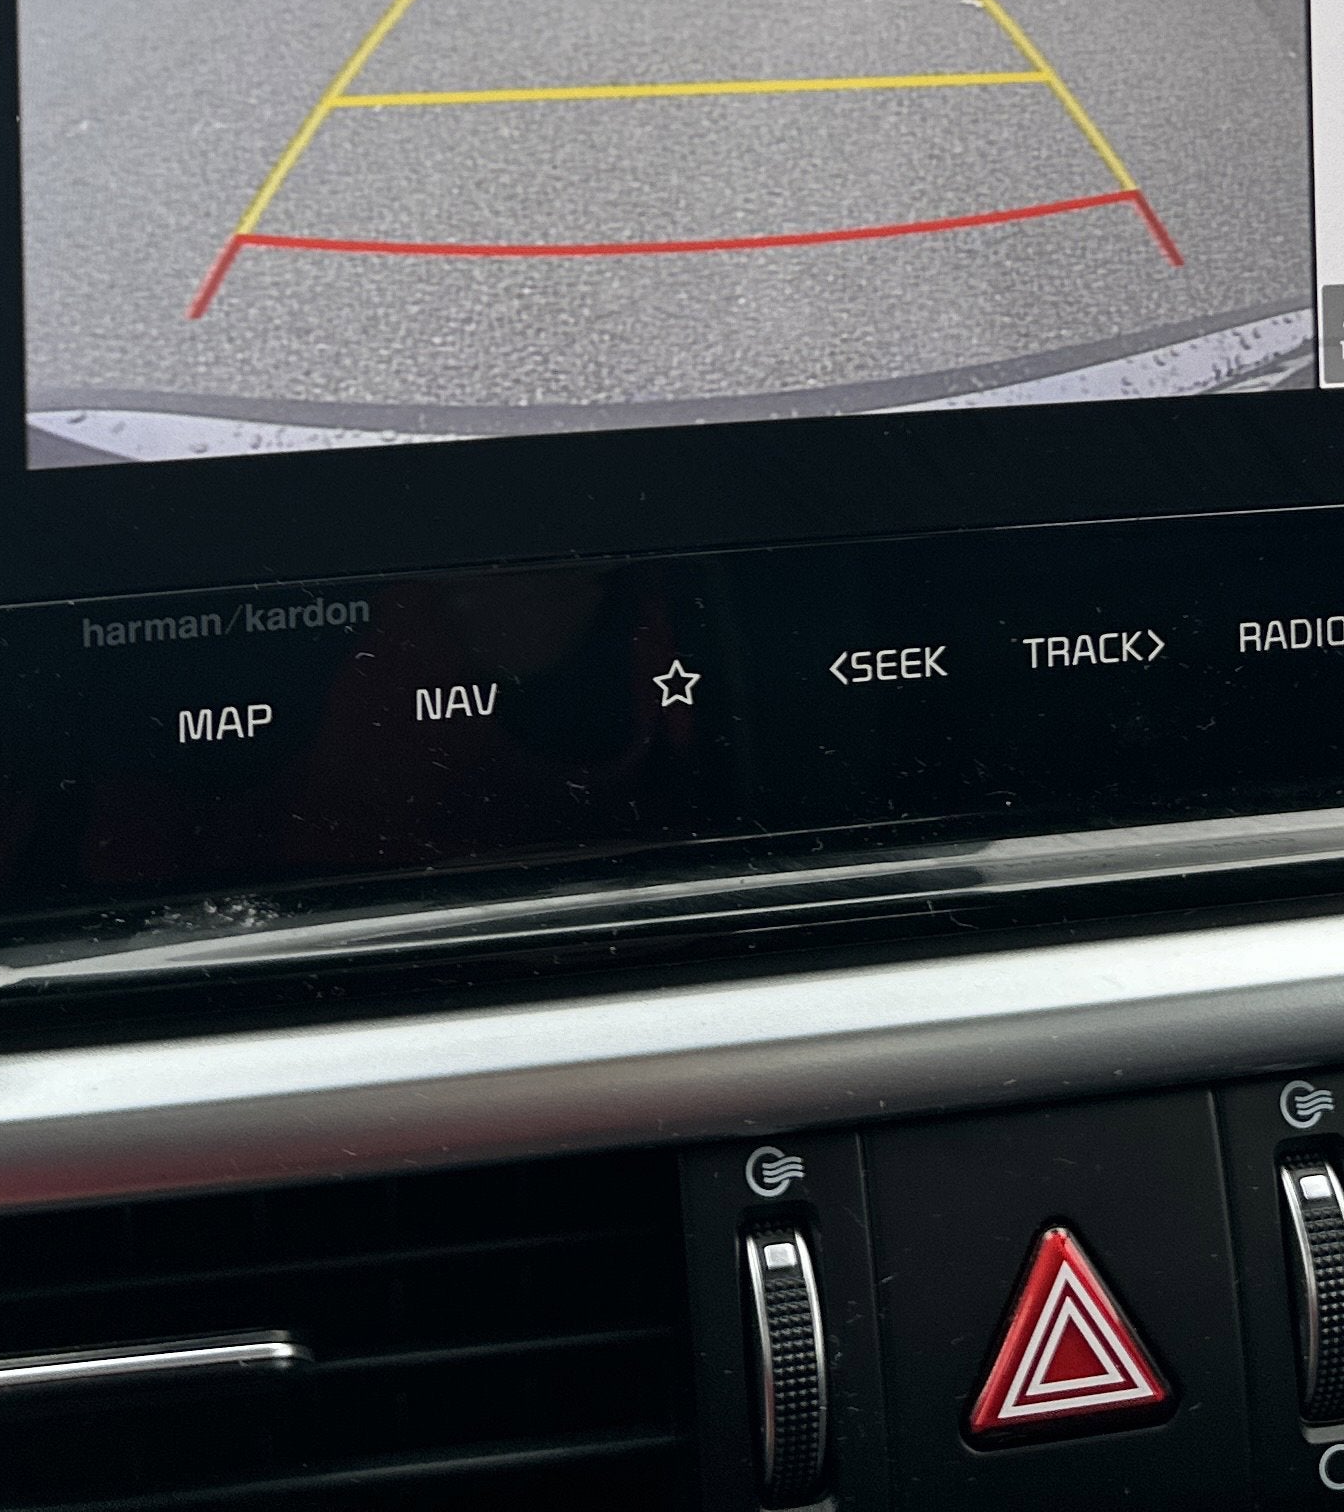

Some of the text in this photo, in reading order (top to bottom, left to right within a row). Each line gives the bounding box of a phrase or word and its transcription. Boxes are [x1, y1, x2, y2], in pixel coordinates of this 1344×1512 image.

[82, 597, 370, 648] harman/kardon
[416, 682, 498, 722] NAV
[179, 703, 273, 744] MAP
